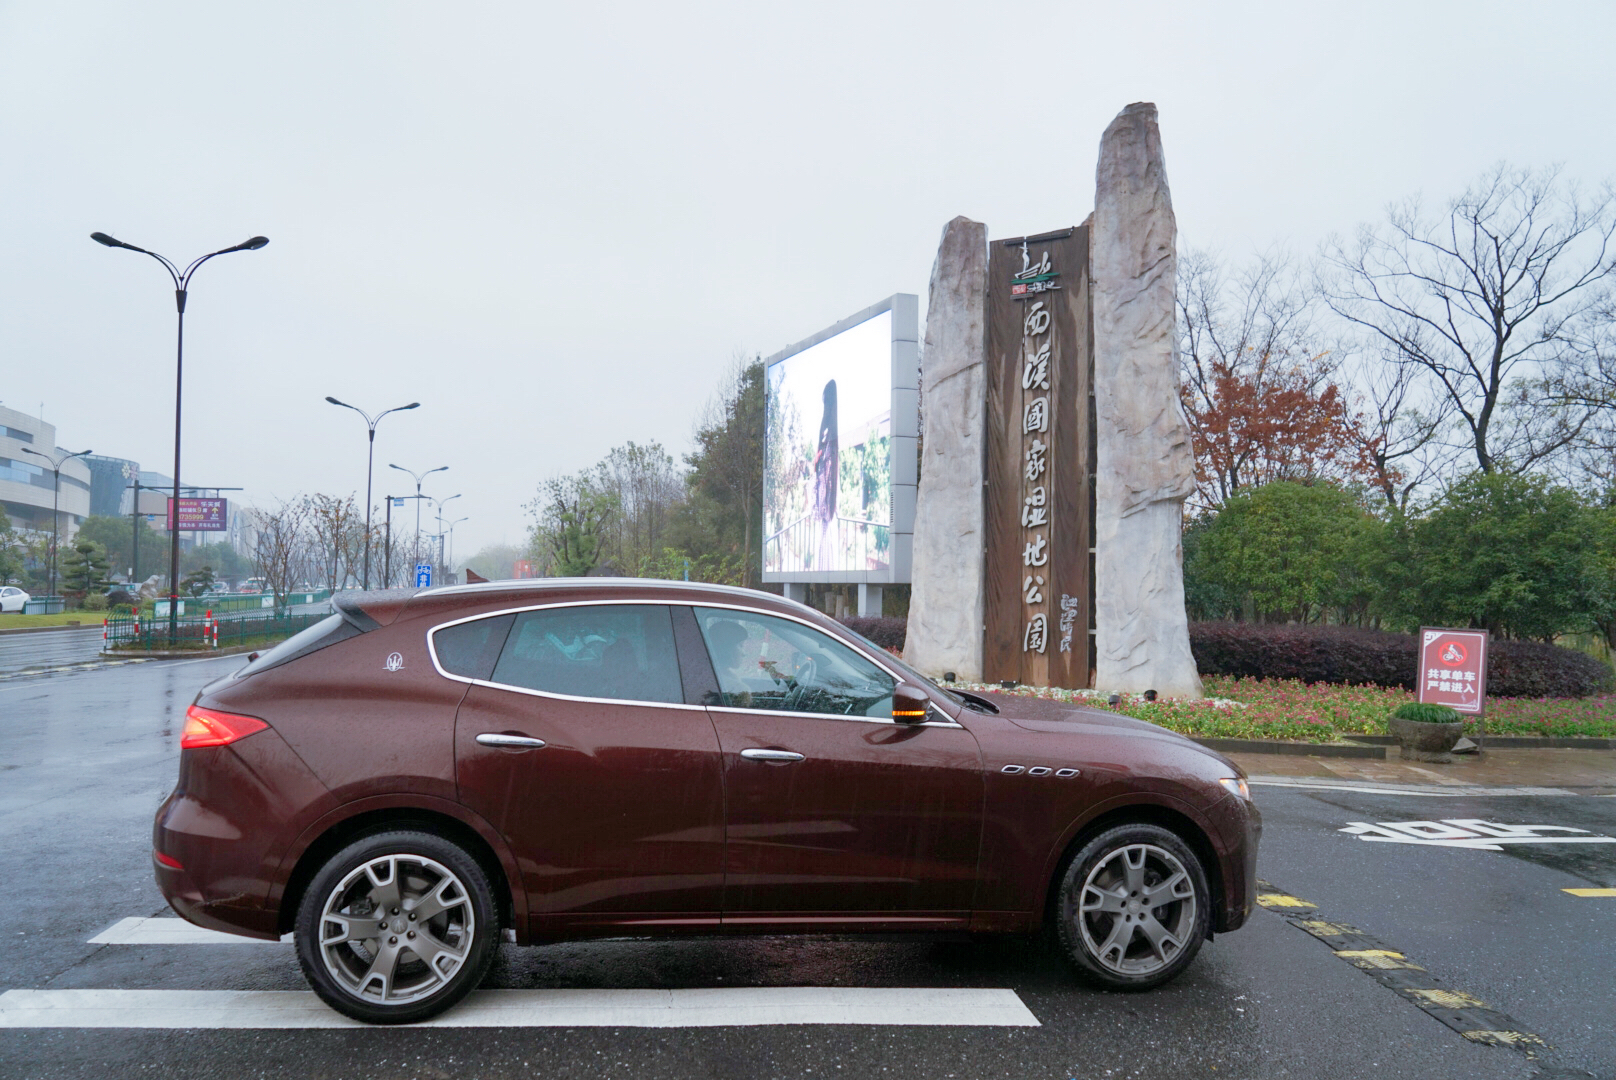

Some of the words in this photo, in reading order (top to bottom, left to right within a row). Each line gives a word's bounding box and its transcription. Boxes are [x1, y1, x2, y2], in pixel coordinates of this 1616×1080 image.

[1428, 669, 1476, 681] 共享单车
[1427, 680, 1474, 693] 严禁进入
